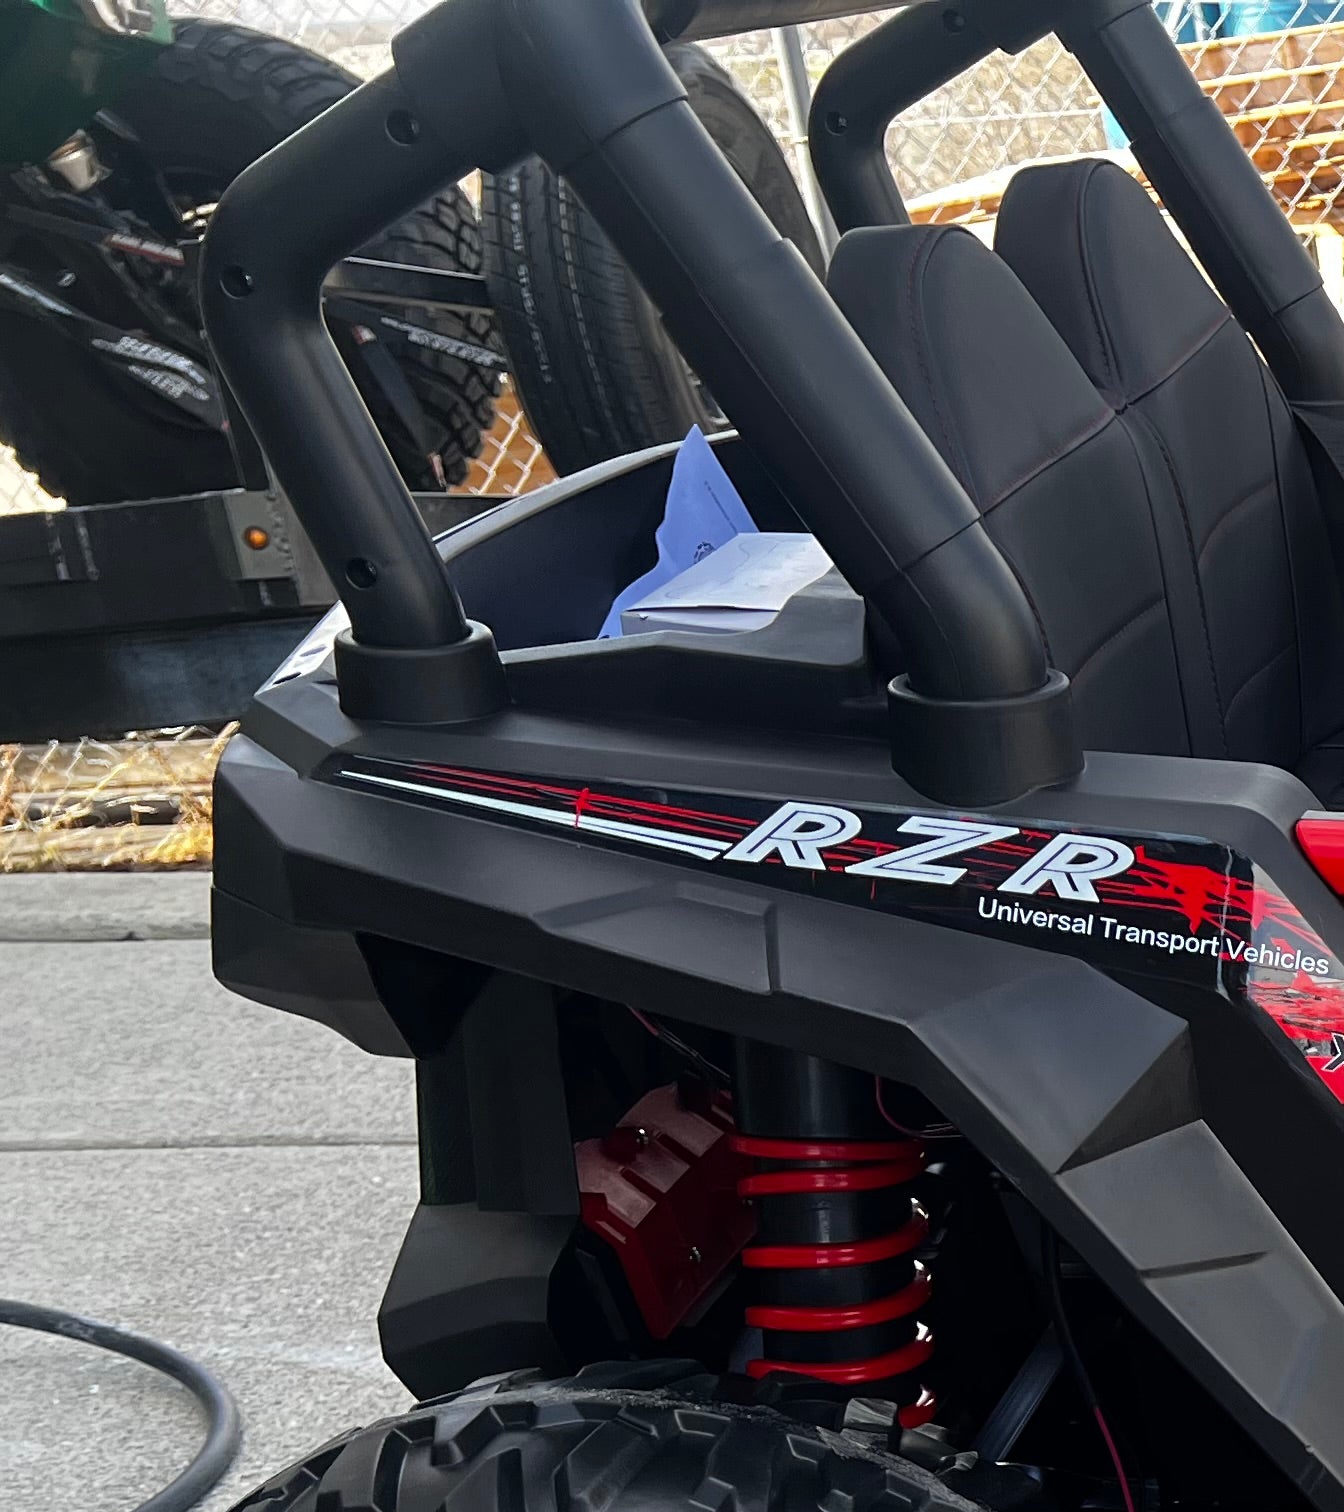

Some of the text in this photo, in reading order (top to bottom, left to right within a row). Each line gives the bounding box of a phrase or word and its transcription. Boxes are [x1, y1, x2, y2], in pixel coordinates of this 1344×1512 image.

[723, 801, 1135, 903] RZR
[978, 896, 1330, 975] Universal Transport Vehicles
